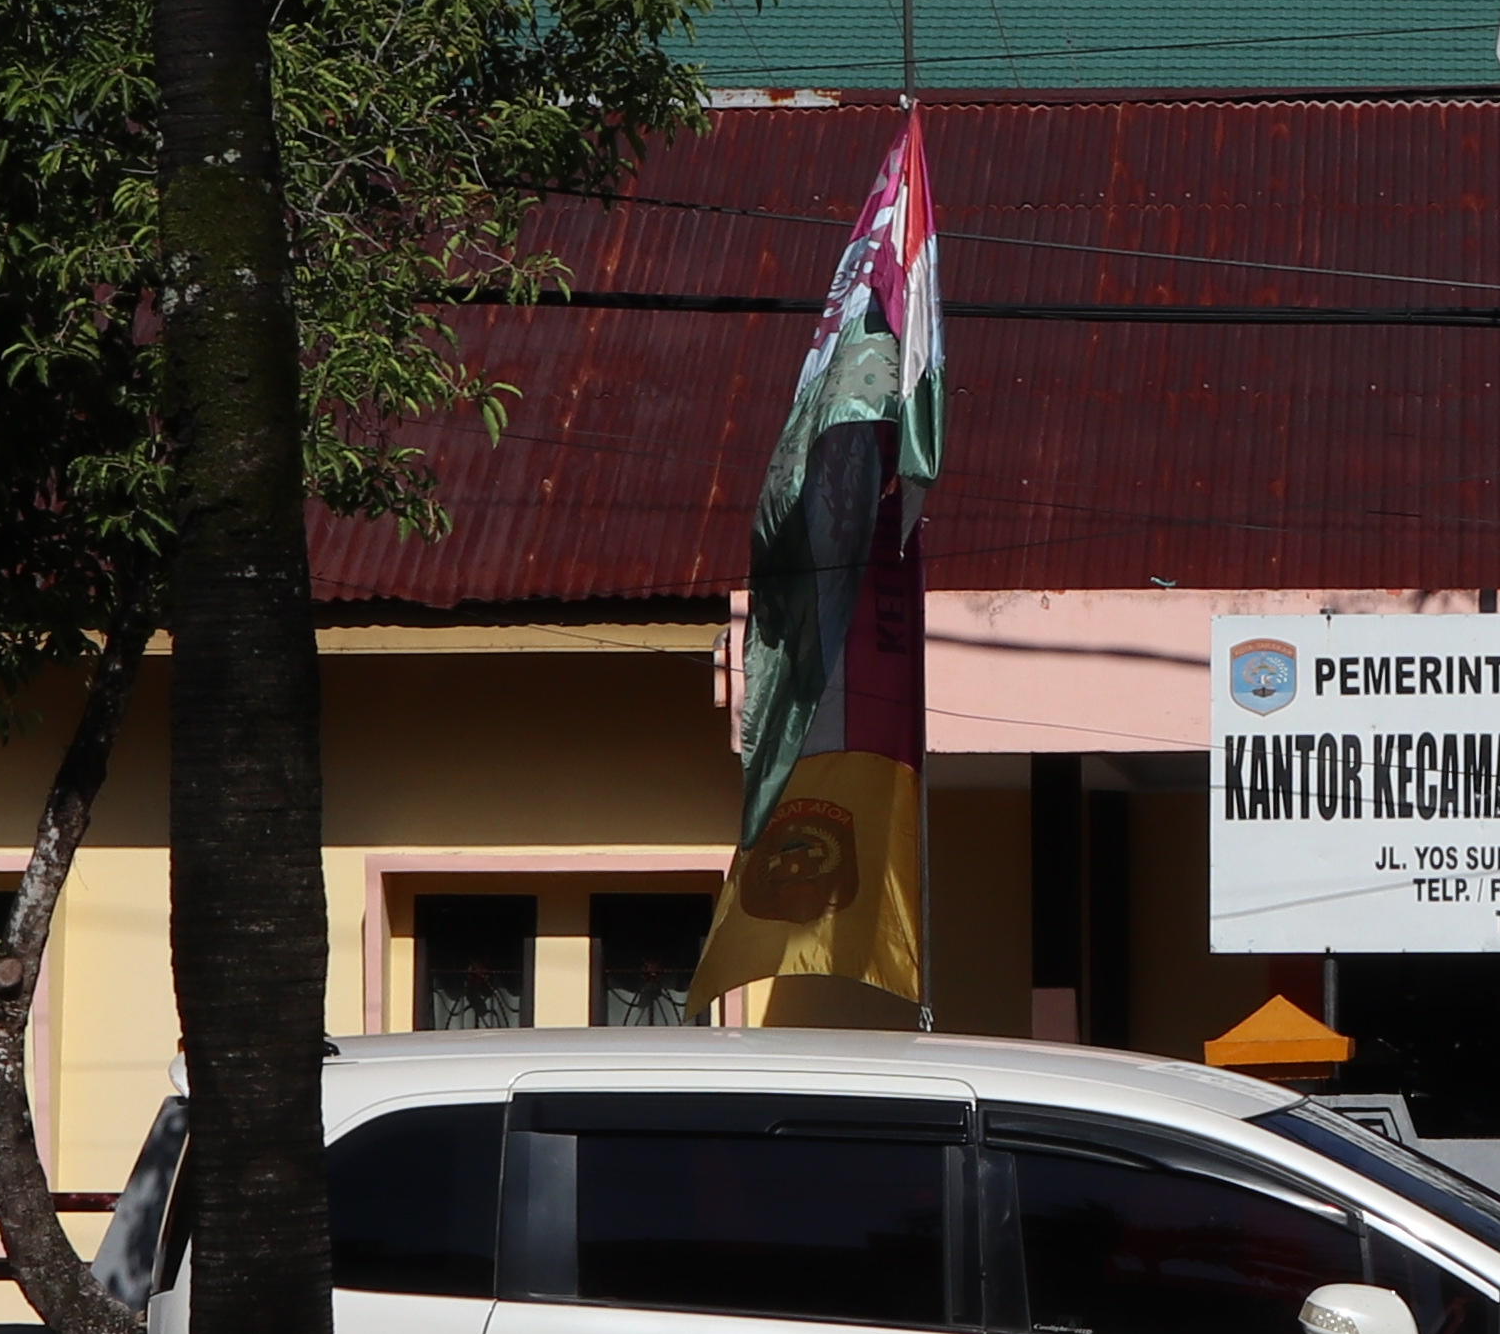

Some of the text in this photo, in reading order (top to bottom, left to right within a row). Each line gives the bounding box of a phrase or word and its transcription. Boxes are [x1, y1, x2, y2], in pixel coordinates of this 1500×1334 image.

[1224, 732, 1362, 820] KANTOR
[1375, 846, 1407, 870] JL.
[1415, 846, 1458, 870] YOS
[1413, 878, 1470, 902] TELP.
